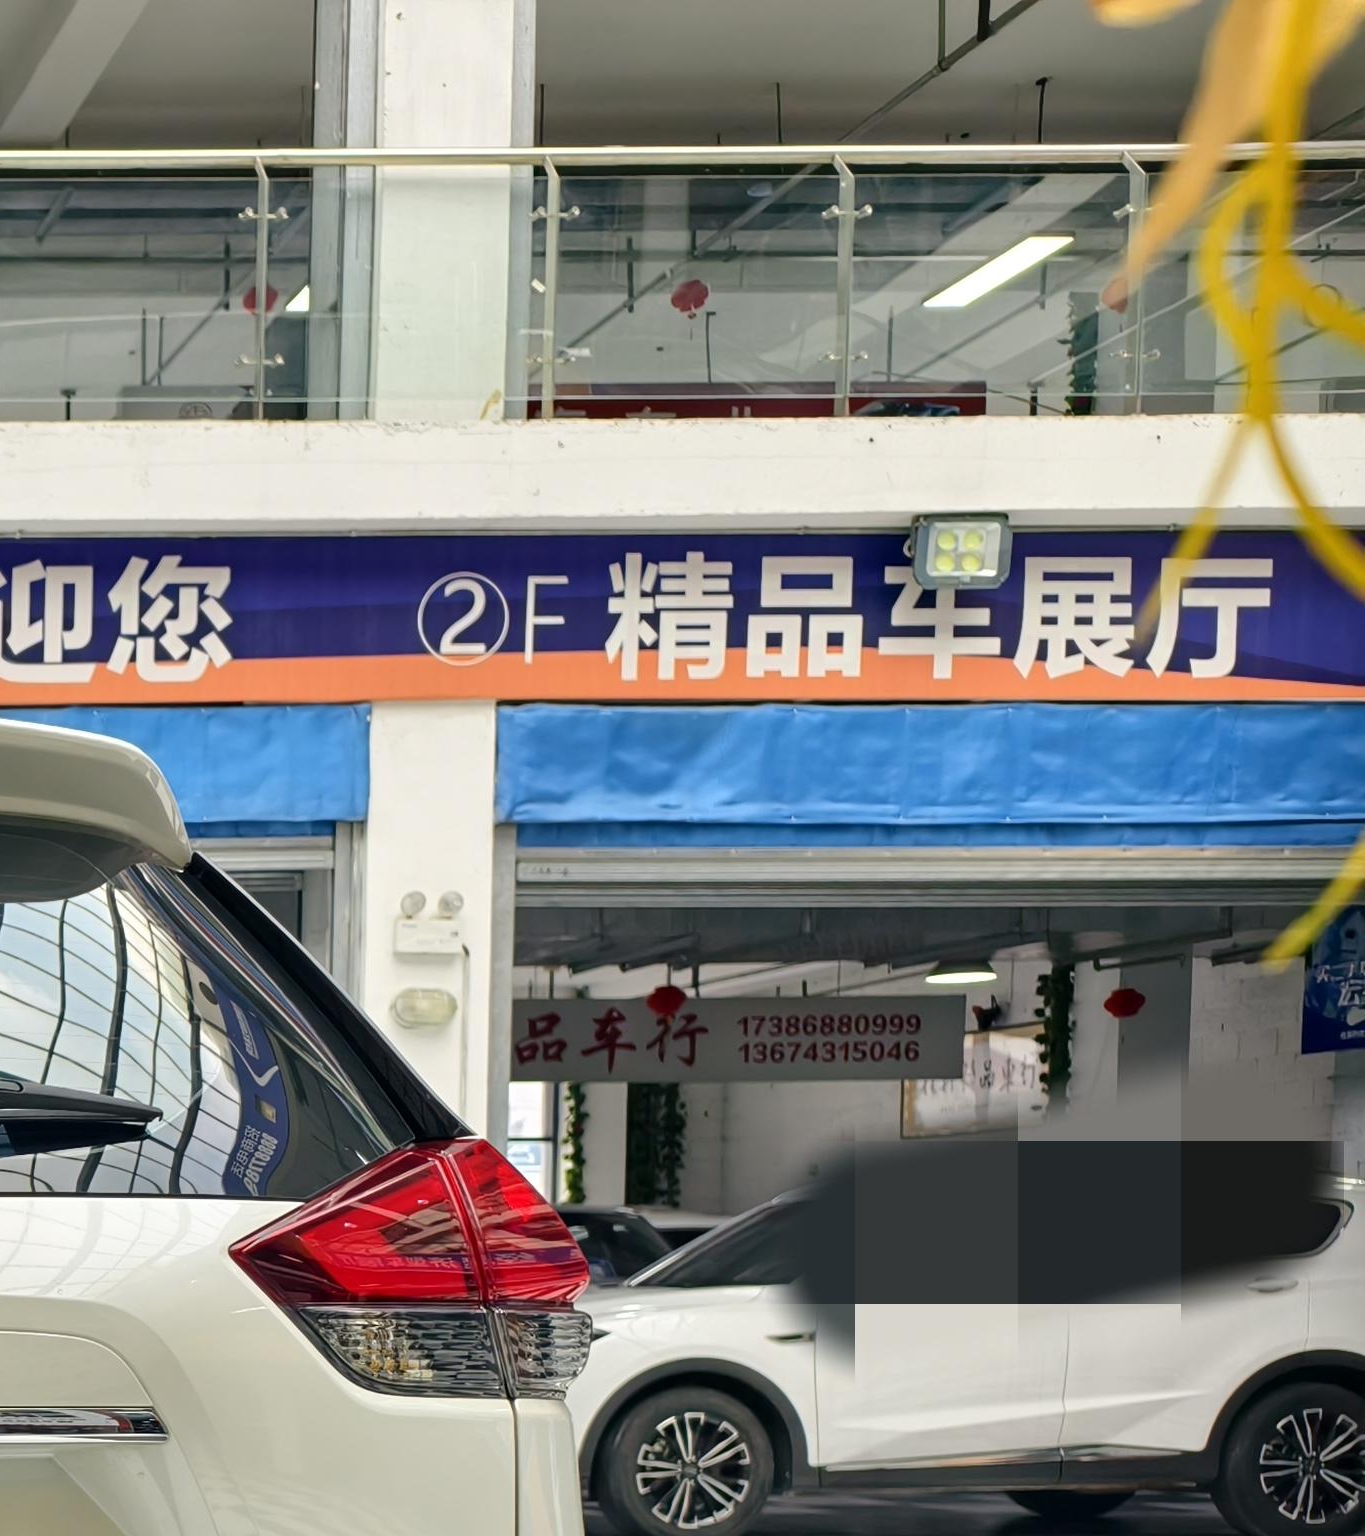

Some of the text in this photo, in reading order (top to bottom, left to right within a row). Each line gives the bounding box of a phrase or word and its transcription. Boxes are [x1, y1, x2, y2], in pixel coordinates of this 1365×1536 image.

[604, 550, 1275, 682] 精品车展厅
[515, 1007, 710, 1075] 品车行
[736, 1013, 922, 1037] 17386880999
[737, 1040, 921, 1064] 13674315046
